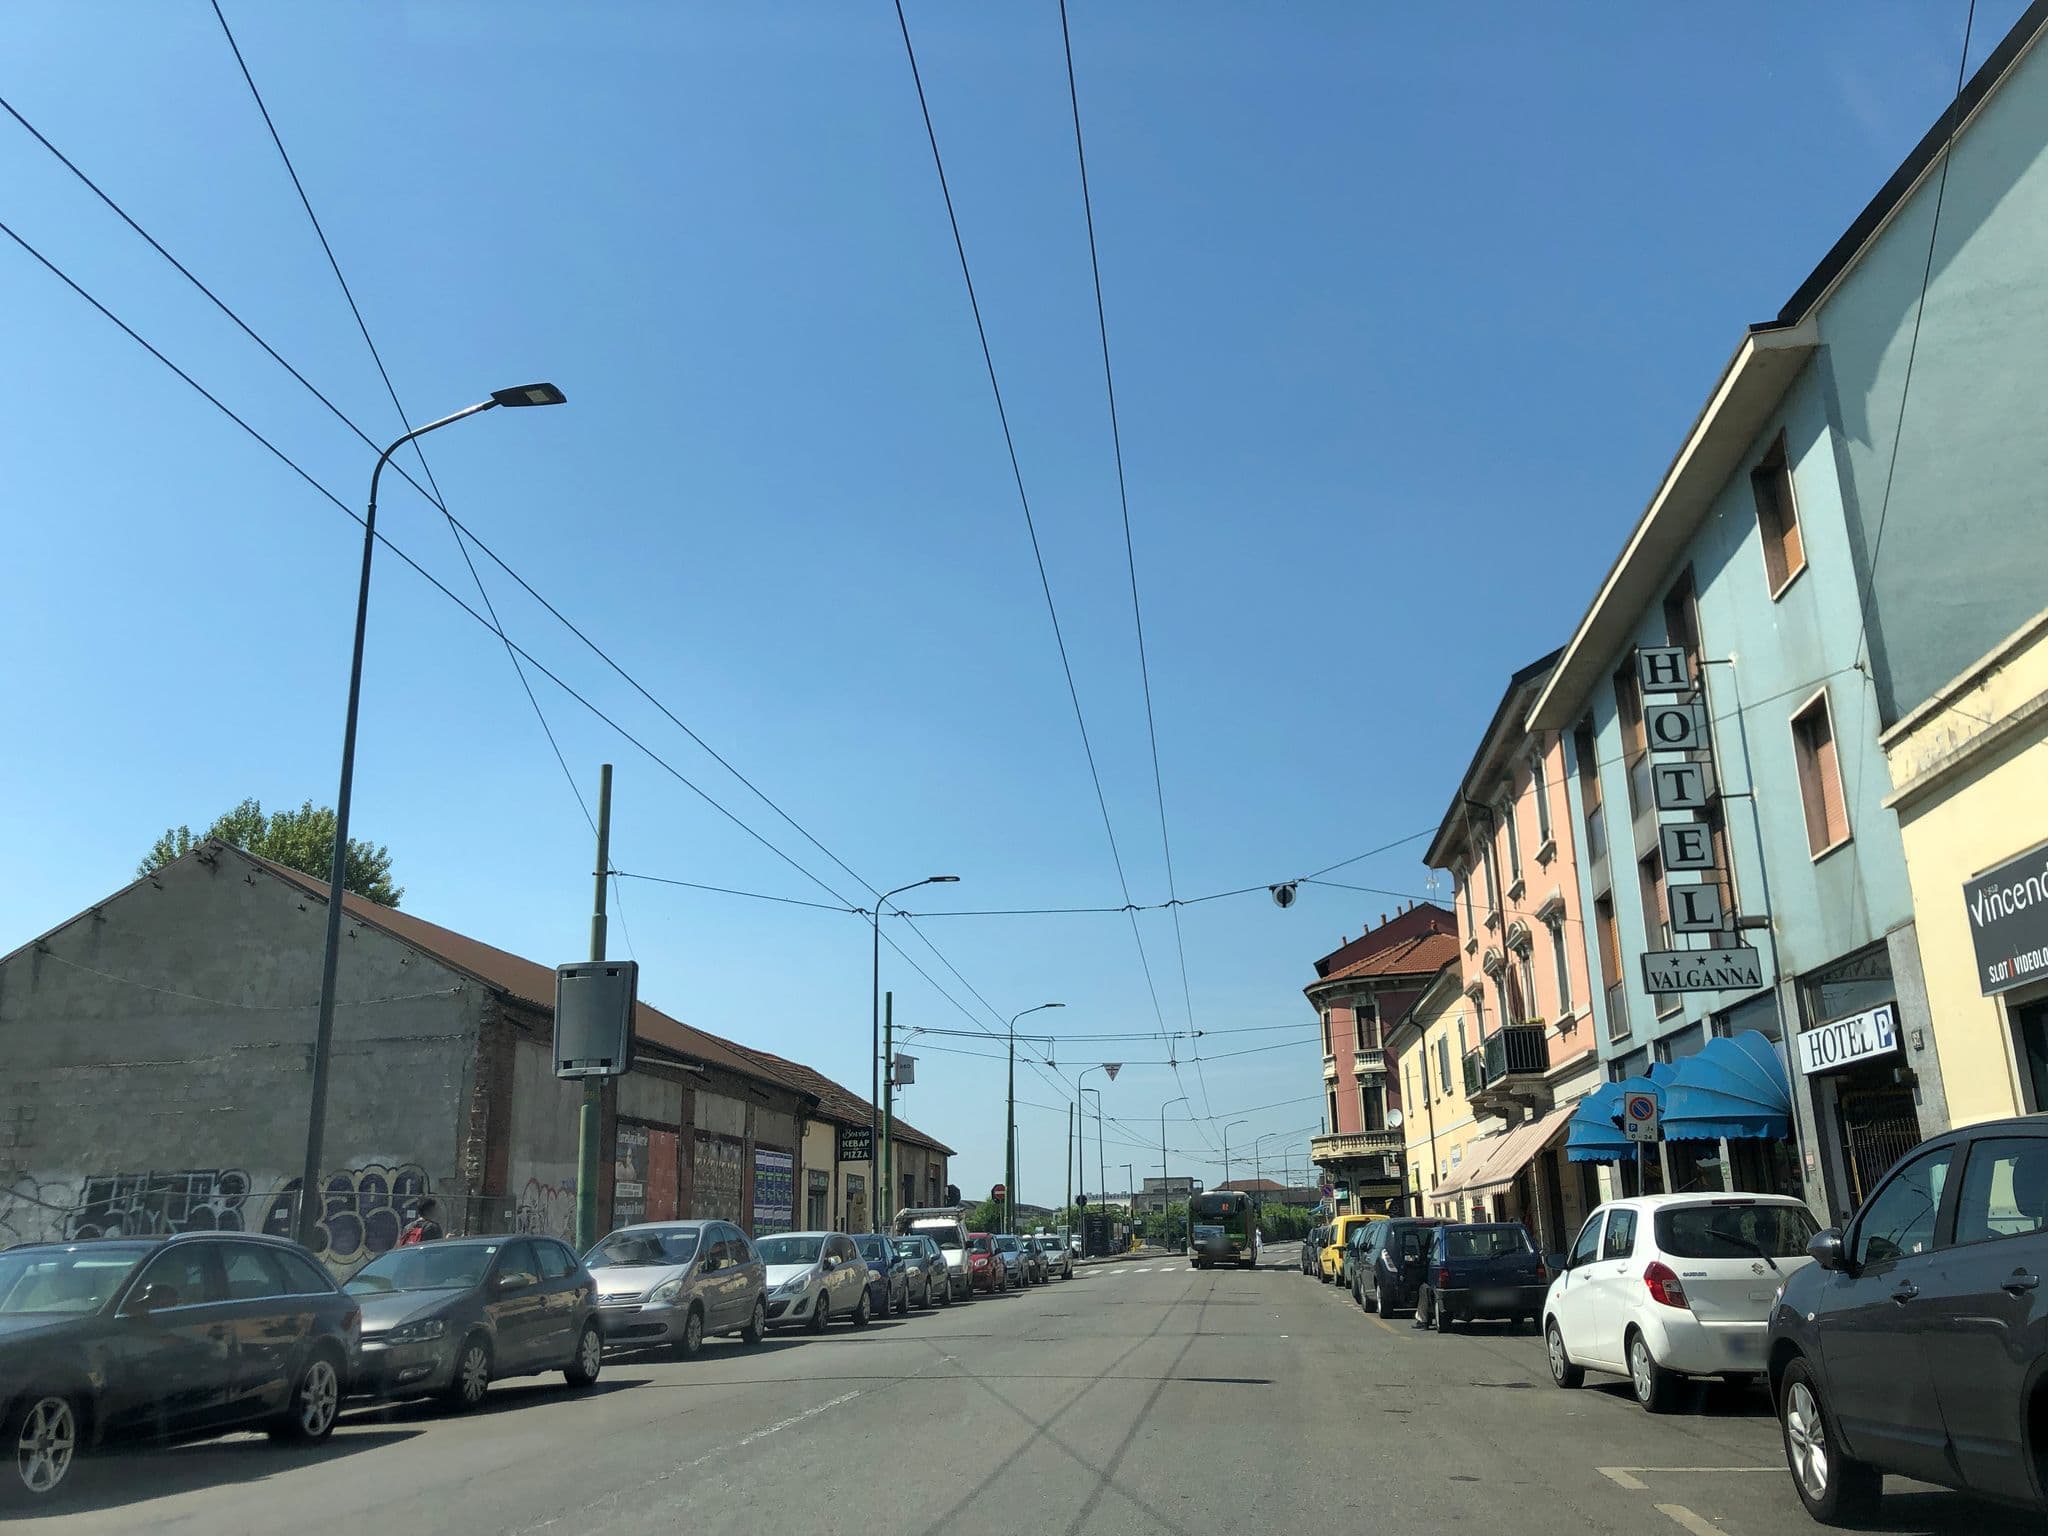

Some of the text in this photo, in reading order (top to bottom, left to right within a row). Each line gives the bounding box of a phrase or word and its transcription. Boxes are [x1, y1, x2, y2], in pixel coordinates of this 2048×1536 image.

[1645, 653, 1714, 925] HOTEL
[1650, 967, 1759, 989] VALGANNA
[1988, 961, 2009, 983] SLOT
[1807, 1018, 1874, 1067] HOTEL
[843, 1150, 868, 1159] PIZZA
